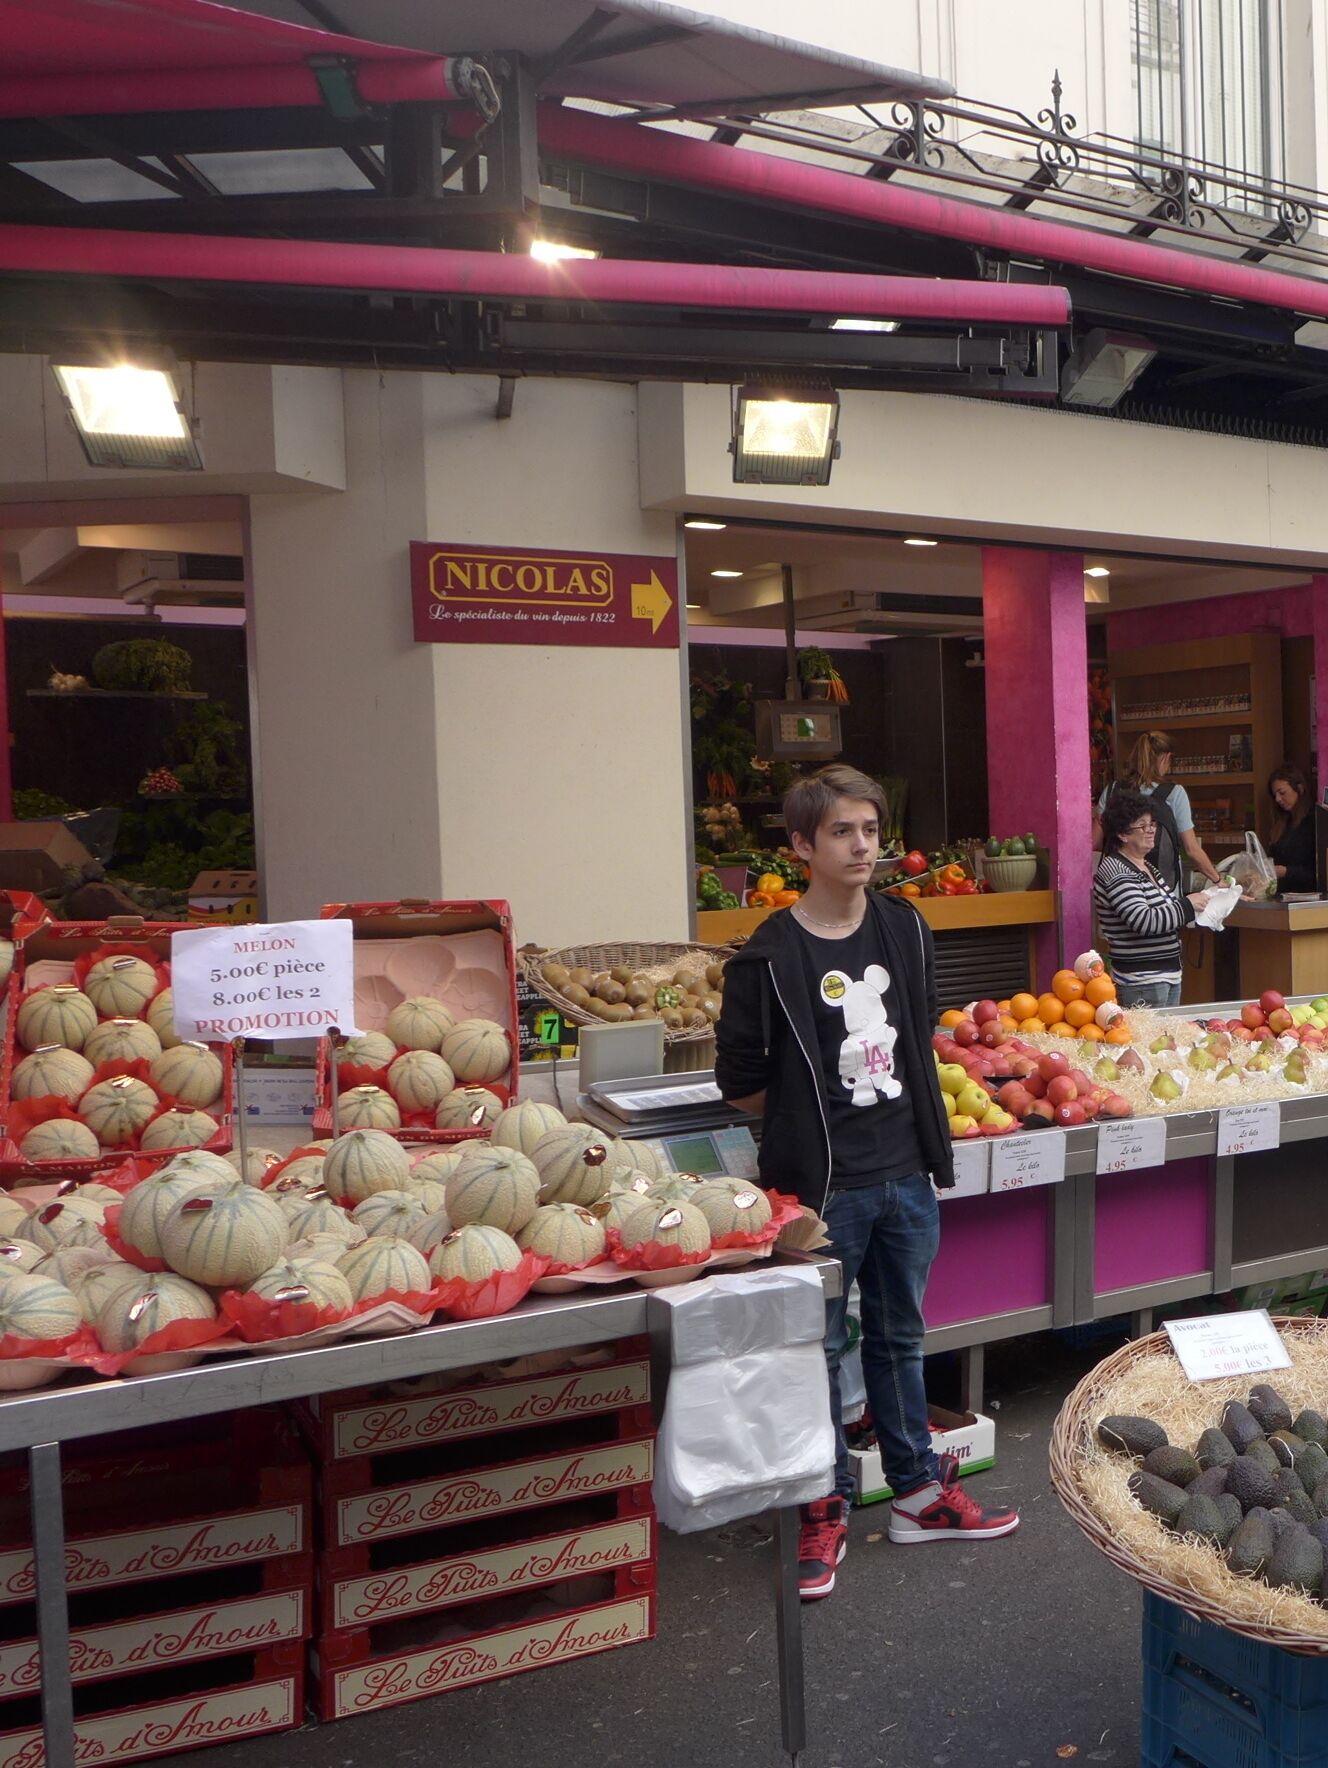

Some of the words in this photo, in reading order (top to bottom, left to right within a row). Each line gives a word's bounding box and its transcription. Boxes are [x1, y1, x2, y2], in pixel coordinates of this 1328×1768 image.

[444, 561, 610, 596] NICOLAS
[429, 604, 452, 620] Le
[453, 608, 513, 624] spécialiste
[514, 610, 530, 621] du
[532, 611, 551, 621] vin
[552, 610, 588, 624] depuis
[590, 612, 616, 624] 1822
[233, 938, 297, 954] MELON
[210, 961, 269, 983] 5.00€
[273, 959, 326, 978] pièce
[212, 987, 271, 1007] 8.00€
[276, 985, 304, 1000] les
[310, 987, 321, 999] 2
[194, 1008, 340, 1034] PROMOTION
[543, 1018, 557, 1040] 7
[859, 1040, 889, 1075] LA
[1226, 1143, 1244, 1153] 4.95
[1016, 1162, 1026, 1172] Le
[1027, 1161, 1040, 1170] kilo
[1105, 1160, 1126, 1172] 4.95
[1001, 1176, 1024, 1190] 5.95
[1173, 1320, 1211, 1333] Avocat
[1245, 1357, 1261, 1369] les
[1263, 1355, 1272, 1367] 3
[353, 1408, 411, 1449] Le
[357, 1492, 415, 1535] Le
[353, 1574, 411, 1618] Le
[353, 1661, 411, 1706] Le
